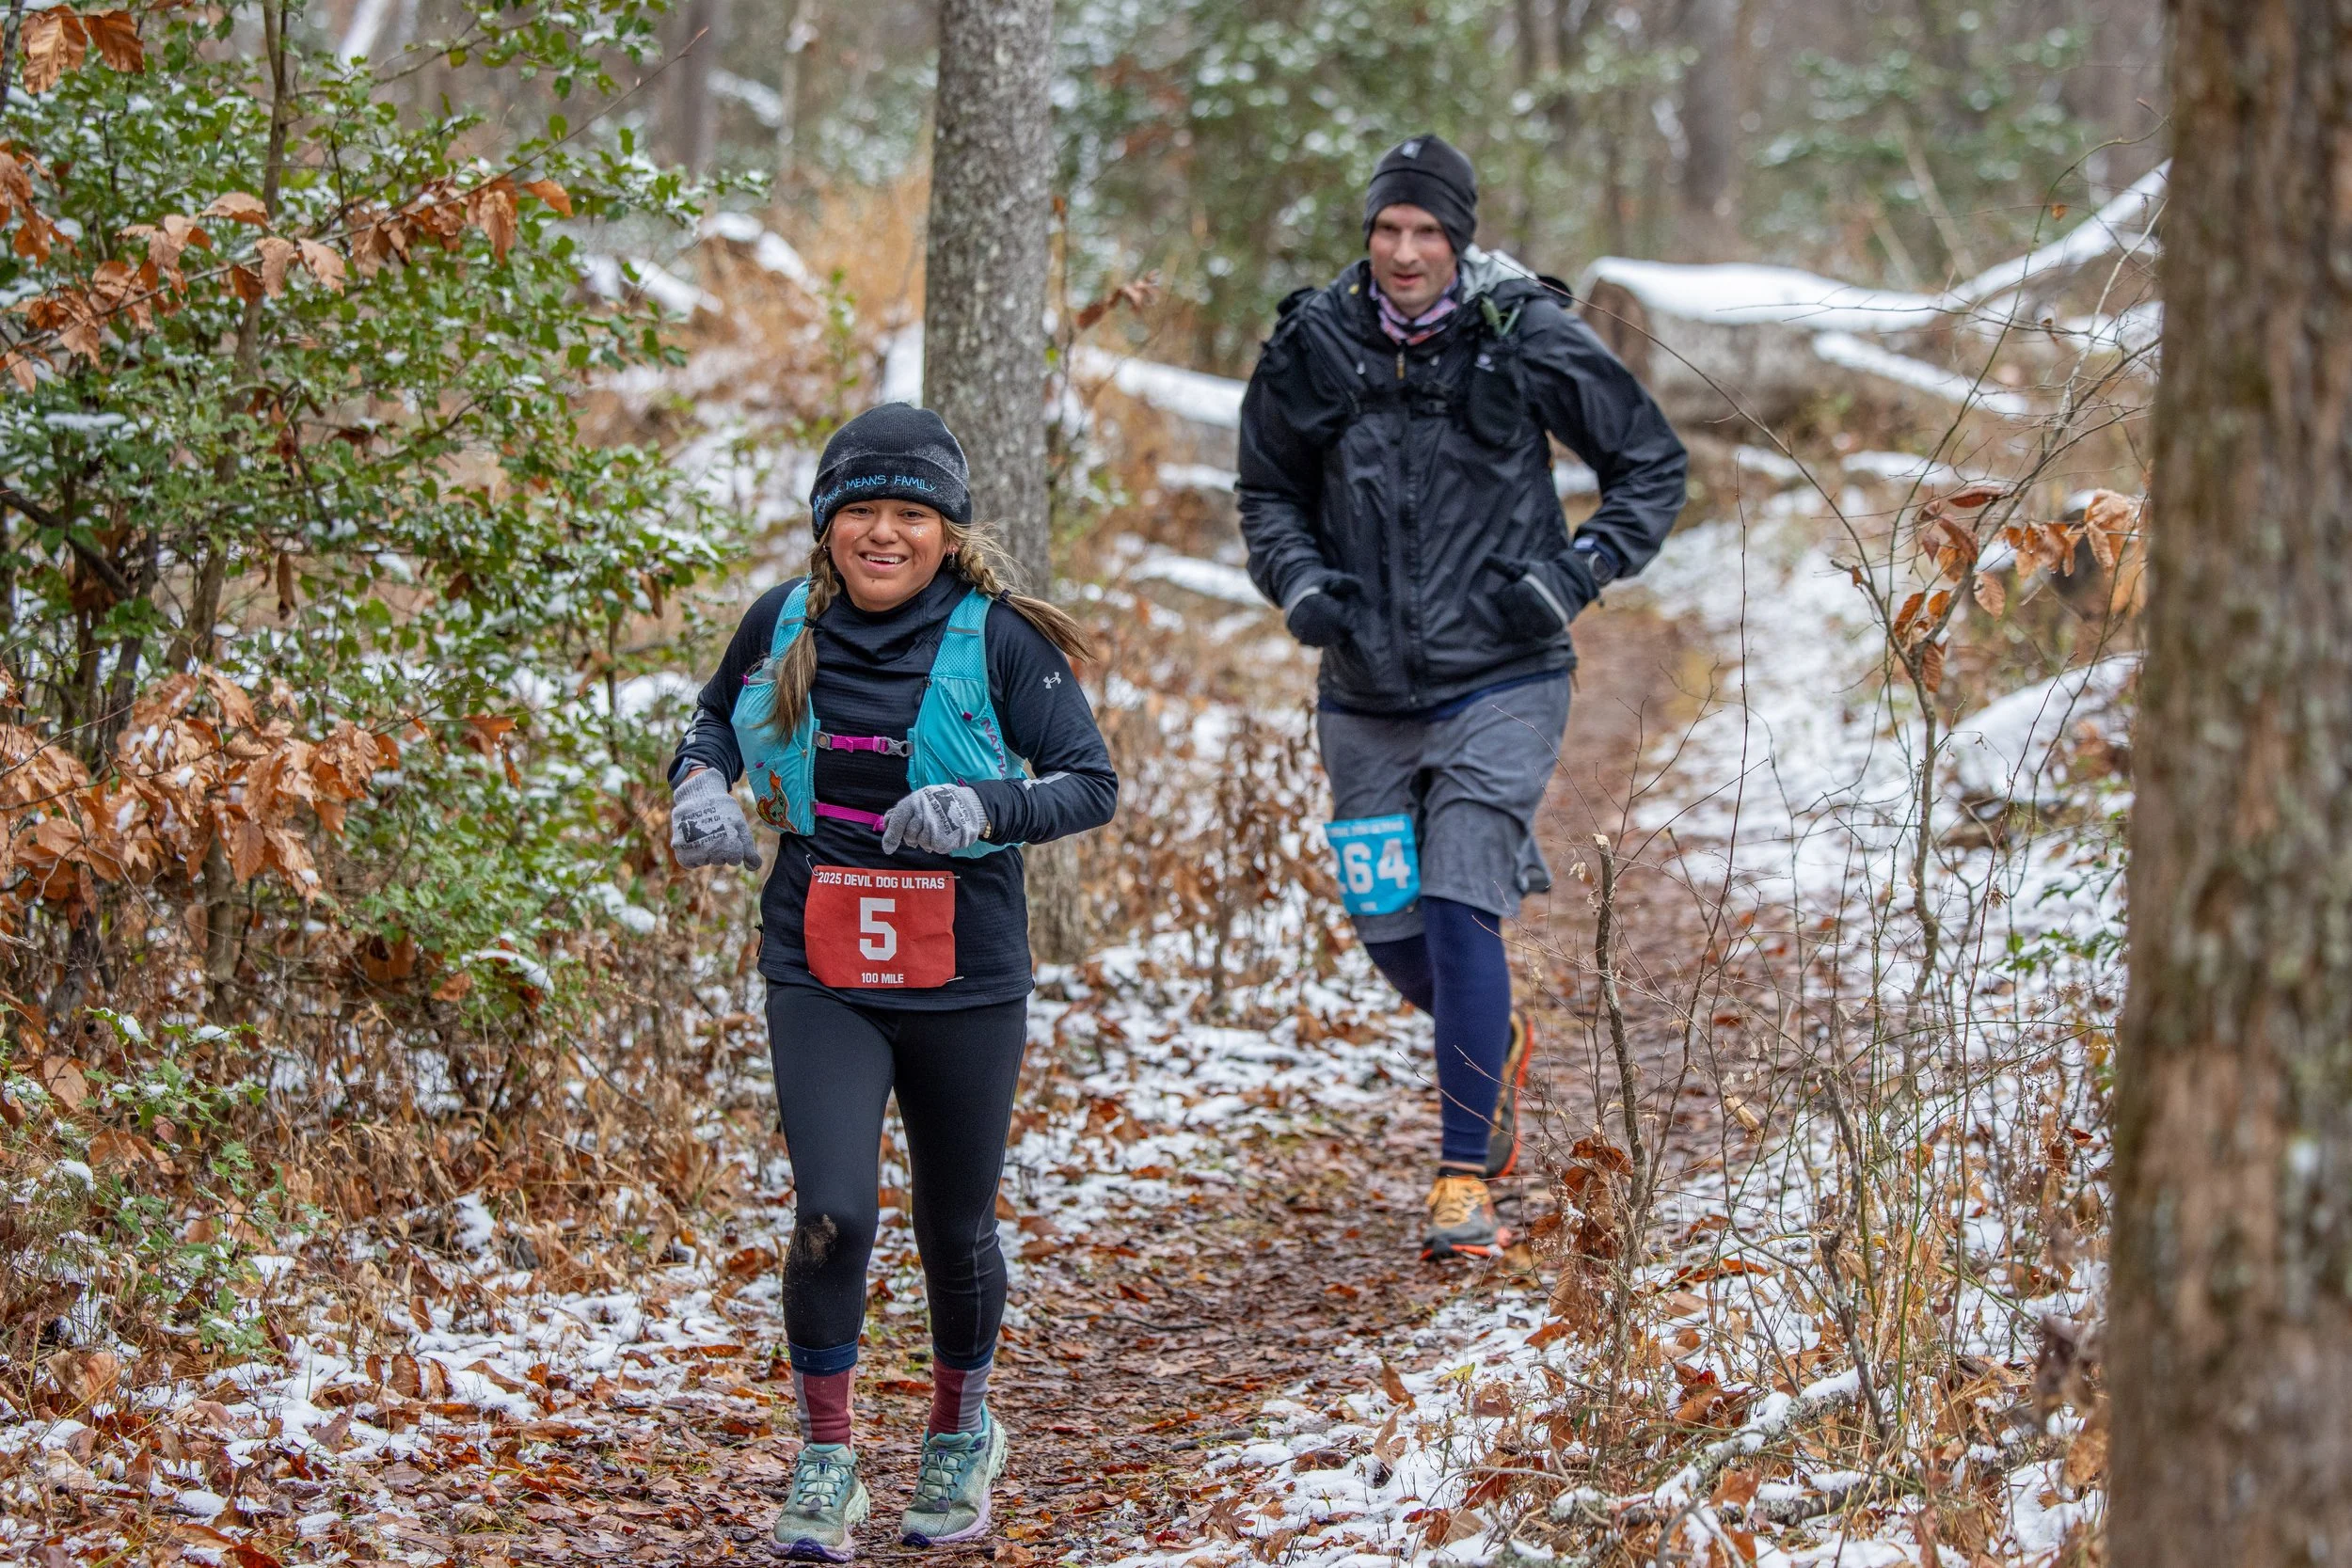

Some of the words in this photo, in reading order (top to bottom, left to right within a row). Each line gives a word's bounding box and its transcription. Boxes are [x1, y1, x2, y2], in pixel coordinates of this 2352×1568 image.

[846, 474, 887, 490] MEANS
[894, 475, 937, 493] FAMILY
[931, 801, 940, 810] DC
[935, 809, 952, 836] Maryland
[700, 832, 728, 846] Maryland
[817, 872, 841, 885] 2025
[844, 874, 872, 888] DEVIL
[876, 877, 898, 889] DOG
[901, 878, 946, 890] ULTRAS
[859, 896, 897, 961] 5
[861, 973, 879, 984] 100
[881, 973, 904, 984] MILE
